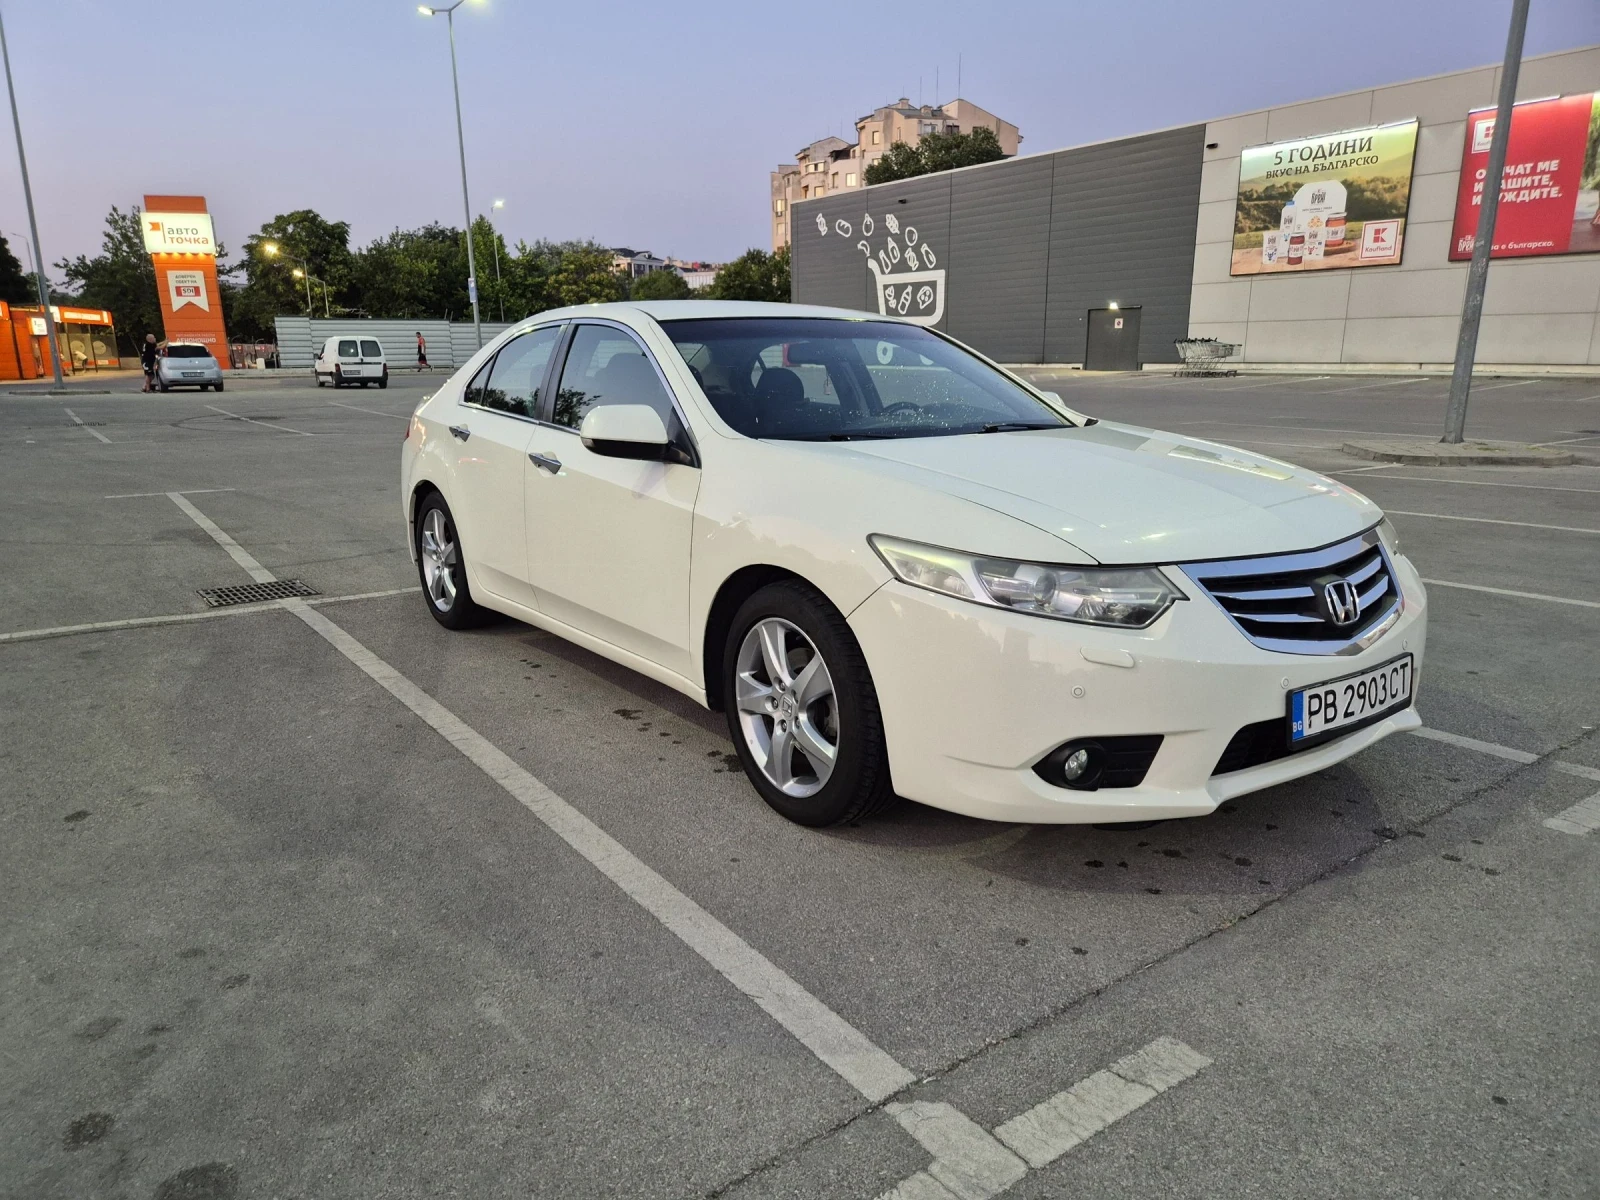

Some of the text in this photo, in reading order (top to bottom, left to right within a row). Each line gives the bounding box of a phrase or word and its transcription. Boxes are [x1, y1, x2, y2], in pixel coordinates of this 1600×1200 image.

[1274, 136, 1373, 166] 5 ГОДИНИ
[1266, 155, 1379, 180] ВКУС НА БЪЛГАРСКО
[1475, 160, 1560, 180] ОЧАТ МЕ
[167, 227, 199, 236] авто
[168, 236, 209, 244] точка
[1365, 245, 1392, 253] Kaufland
[1308, 689, 1338, 729] PB
[1292, 720, 1303, 733] BG
